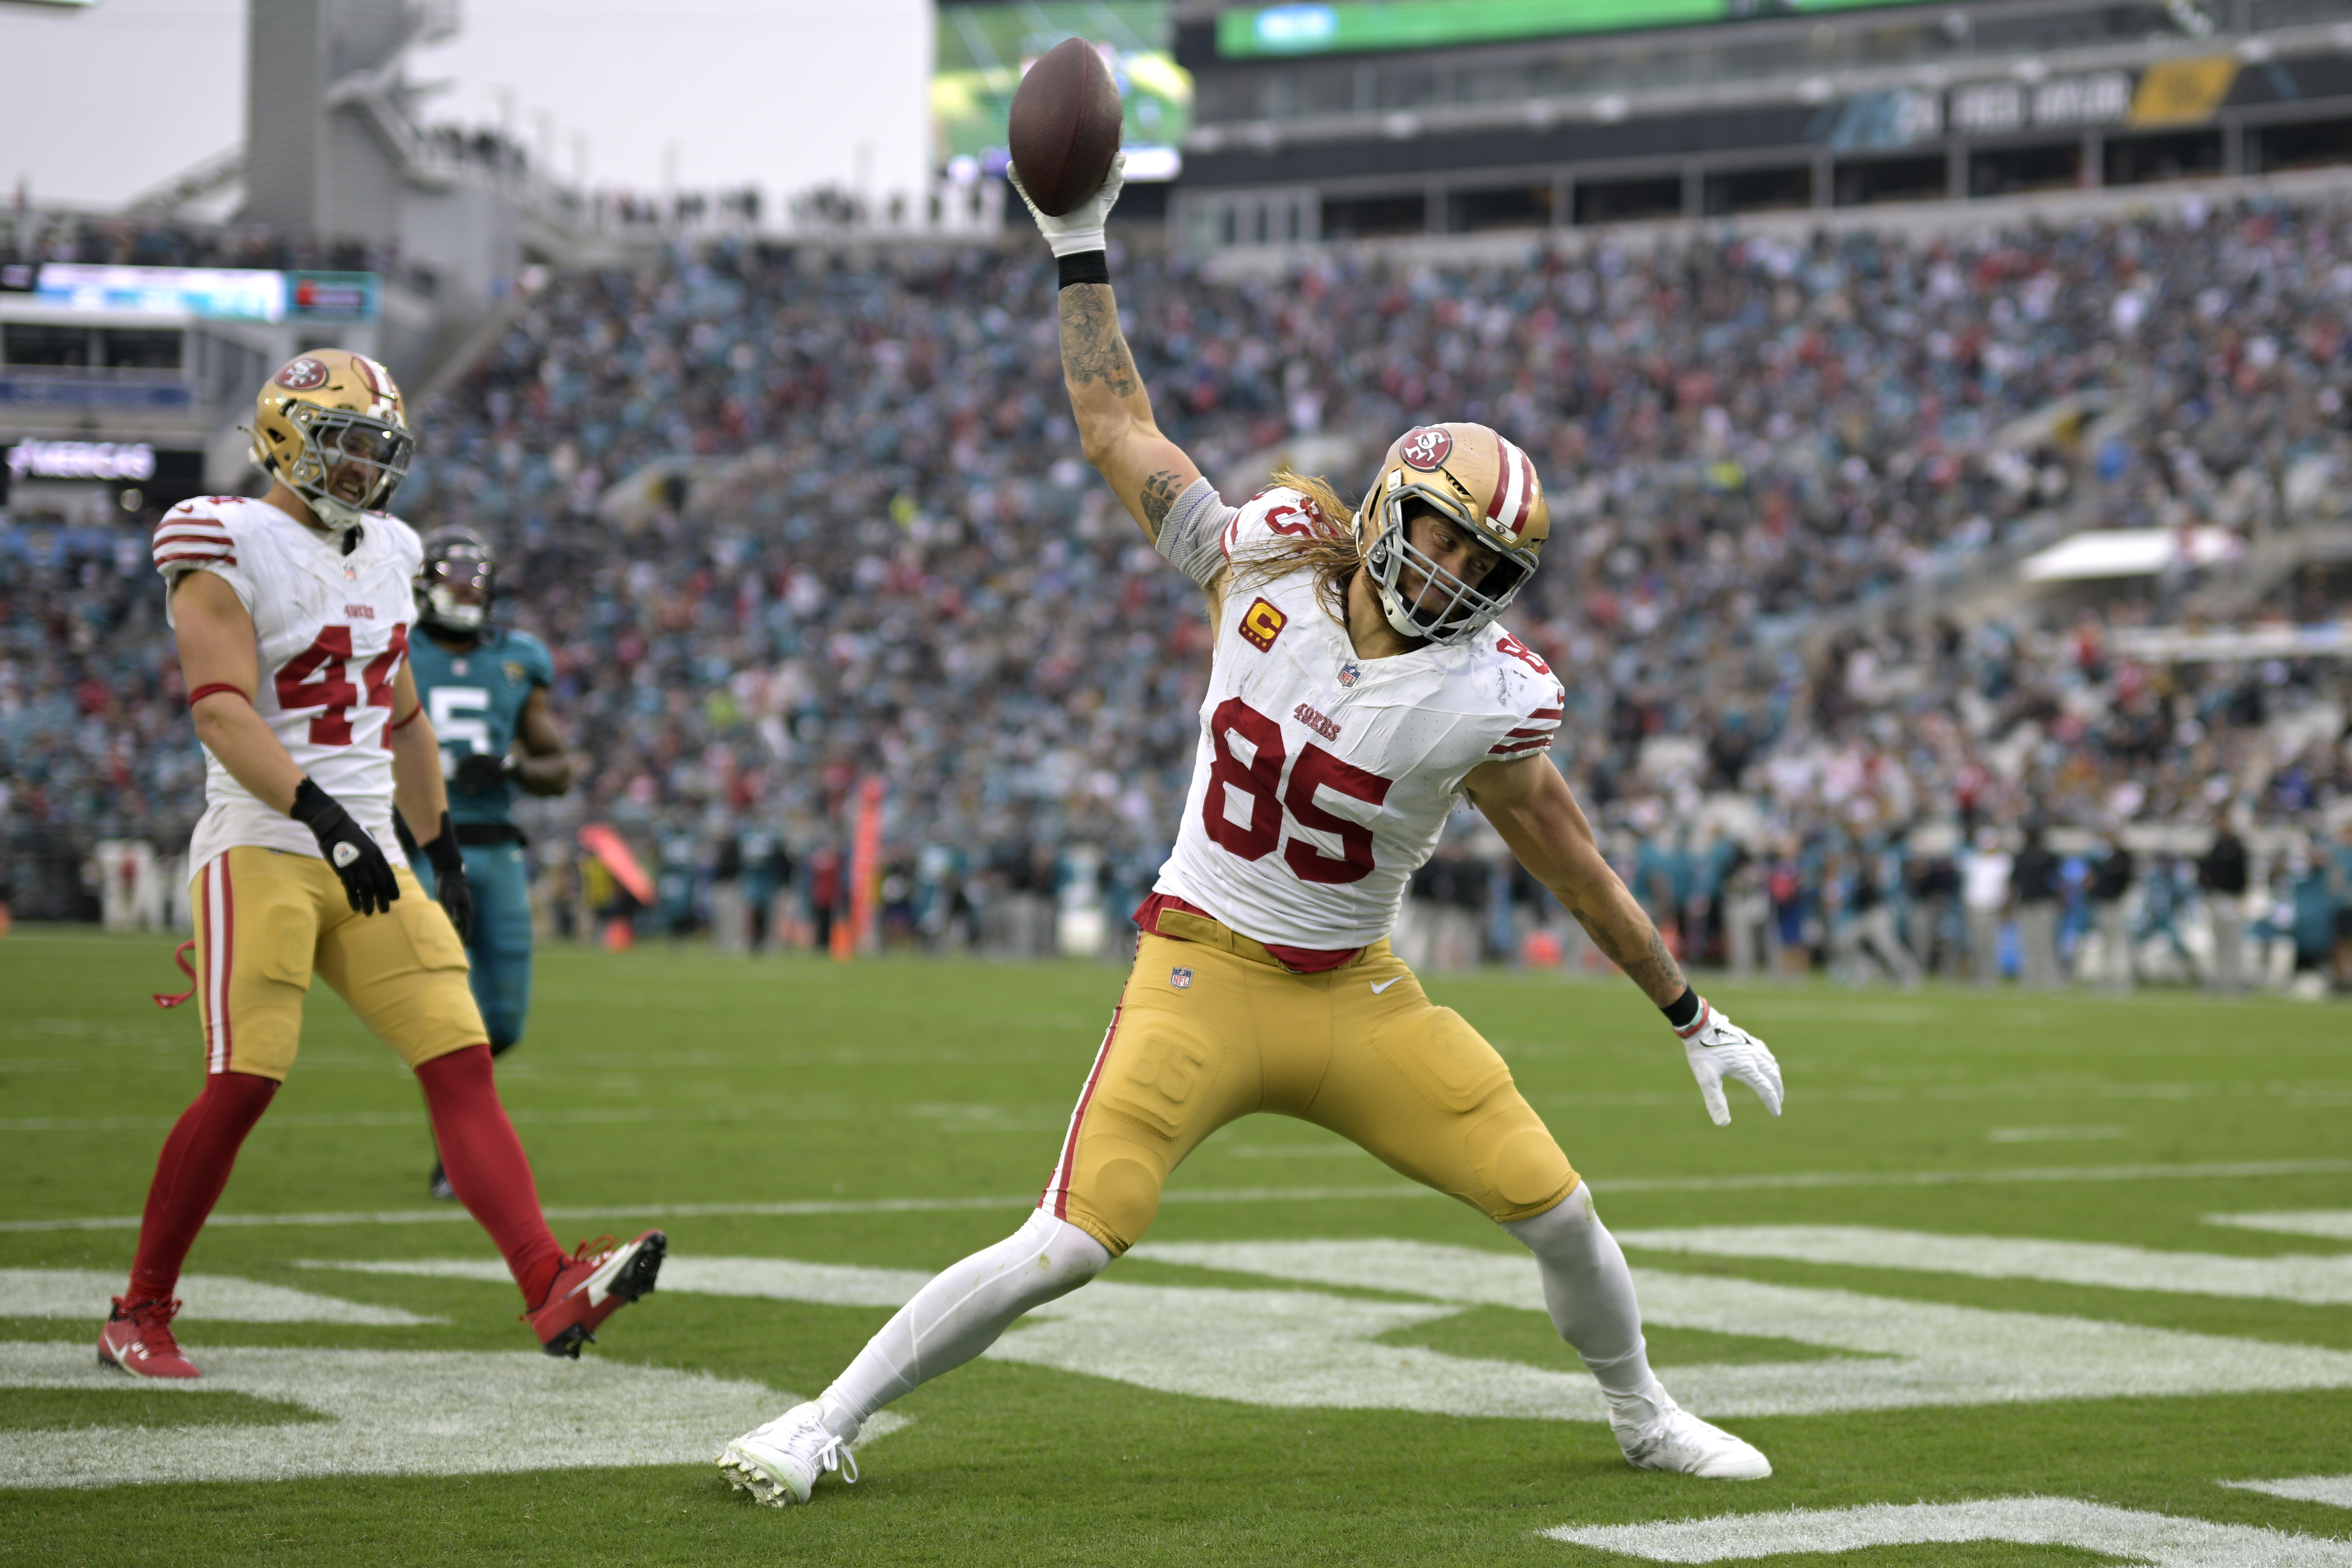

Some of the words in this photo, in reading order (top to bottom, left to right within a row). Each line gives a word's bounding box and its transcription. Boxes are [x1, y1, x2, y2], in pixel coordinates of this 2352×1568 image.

[1247, 603, 1281, 639] C
[274, 623, 409, 749] 44
[1339, 671, 1355, 686] NFL
[428, 686, 492, 784] 5
[1294, 703, 1341, 741] 49ERS
[1202, 696, 1393, 884] 85
[1173, 975, 1188, 986] NFL
